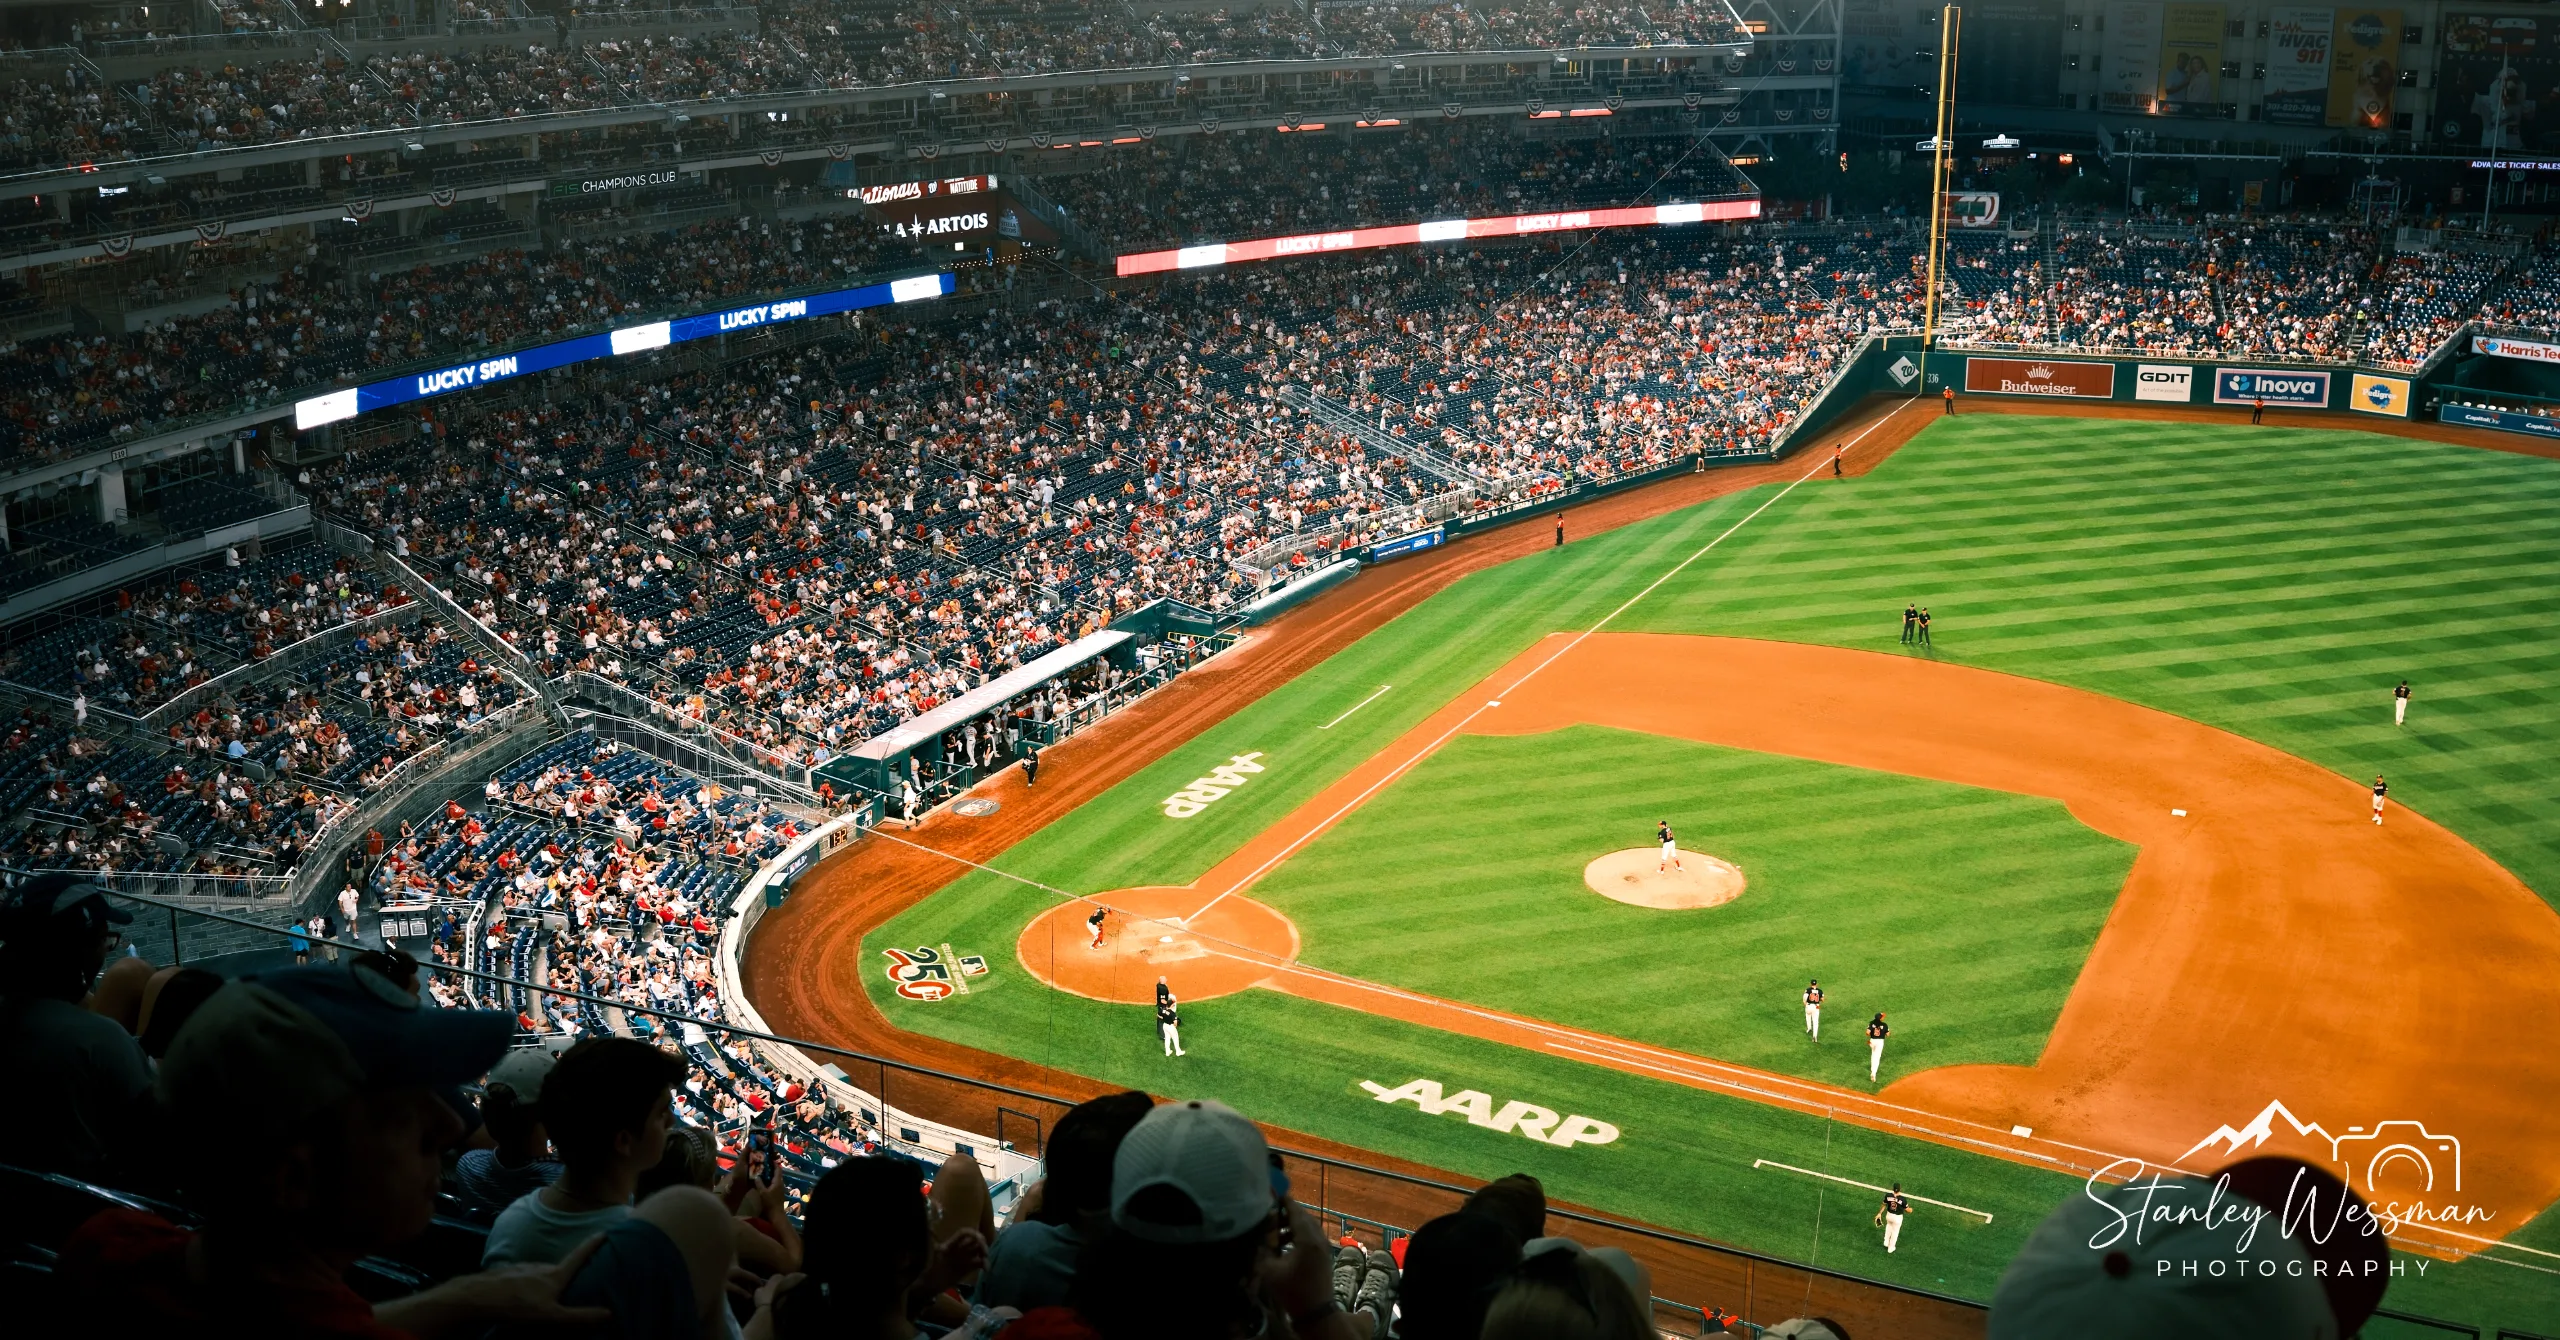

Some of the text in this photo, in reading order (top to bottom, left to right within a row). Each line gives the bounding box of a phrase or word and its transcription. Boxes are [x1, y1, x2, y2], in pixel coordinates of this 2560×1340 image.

[2343, 23, 2393, 37] Pedigree
[2278, 34, 2329, 49] HVAC
[2296, 49, 2325, 64] 911
[2104, 92, 2152, 107] THANK YOU
[2509, 161, 2537, 169] TICKET
[2537, 162, 2560, 170] SALES
[582, 174, 646, 193] CHAMPIONS
[649, 171, 676, 185] CLUB
[950, 180, 978, 194] NATITUDE
[926, 212, 988, 235] ARTOIS
[1516, 212, 1590, 231] LUCKY SPIN
[1276, 233, 1354, 254] LUCKY SPIN
[719, 300, 807, 330] LUCKY SPIN
[2501, 342, 2541, 358] Harris
[418, 356, 518, 395] LUCKY SPIN
[1927, 373, 1939, 384] 336
[2140, 372, 2190, 383] GDIT
[2001, 379, 2075, 395] Budweiser
[2255, 375, 2316, 394] Inova
[2361, 387, 2398, 403] Pedigree
[1161, 751, 1266, 819] AARP
[1358, 1078, 1620, 1148] AARP
